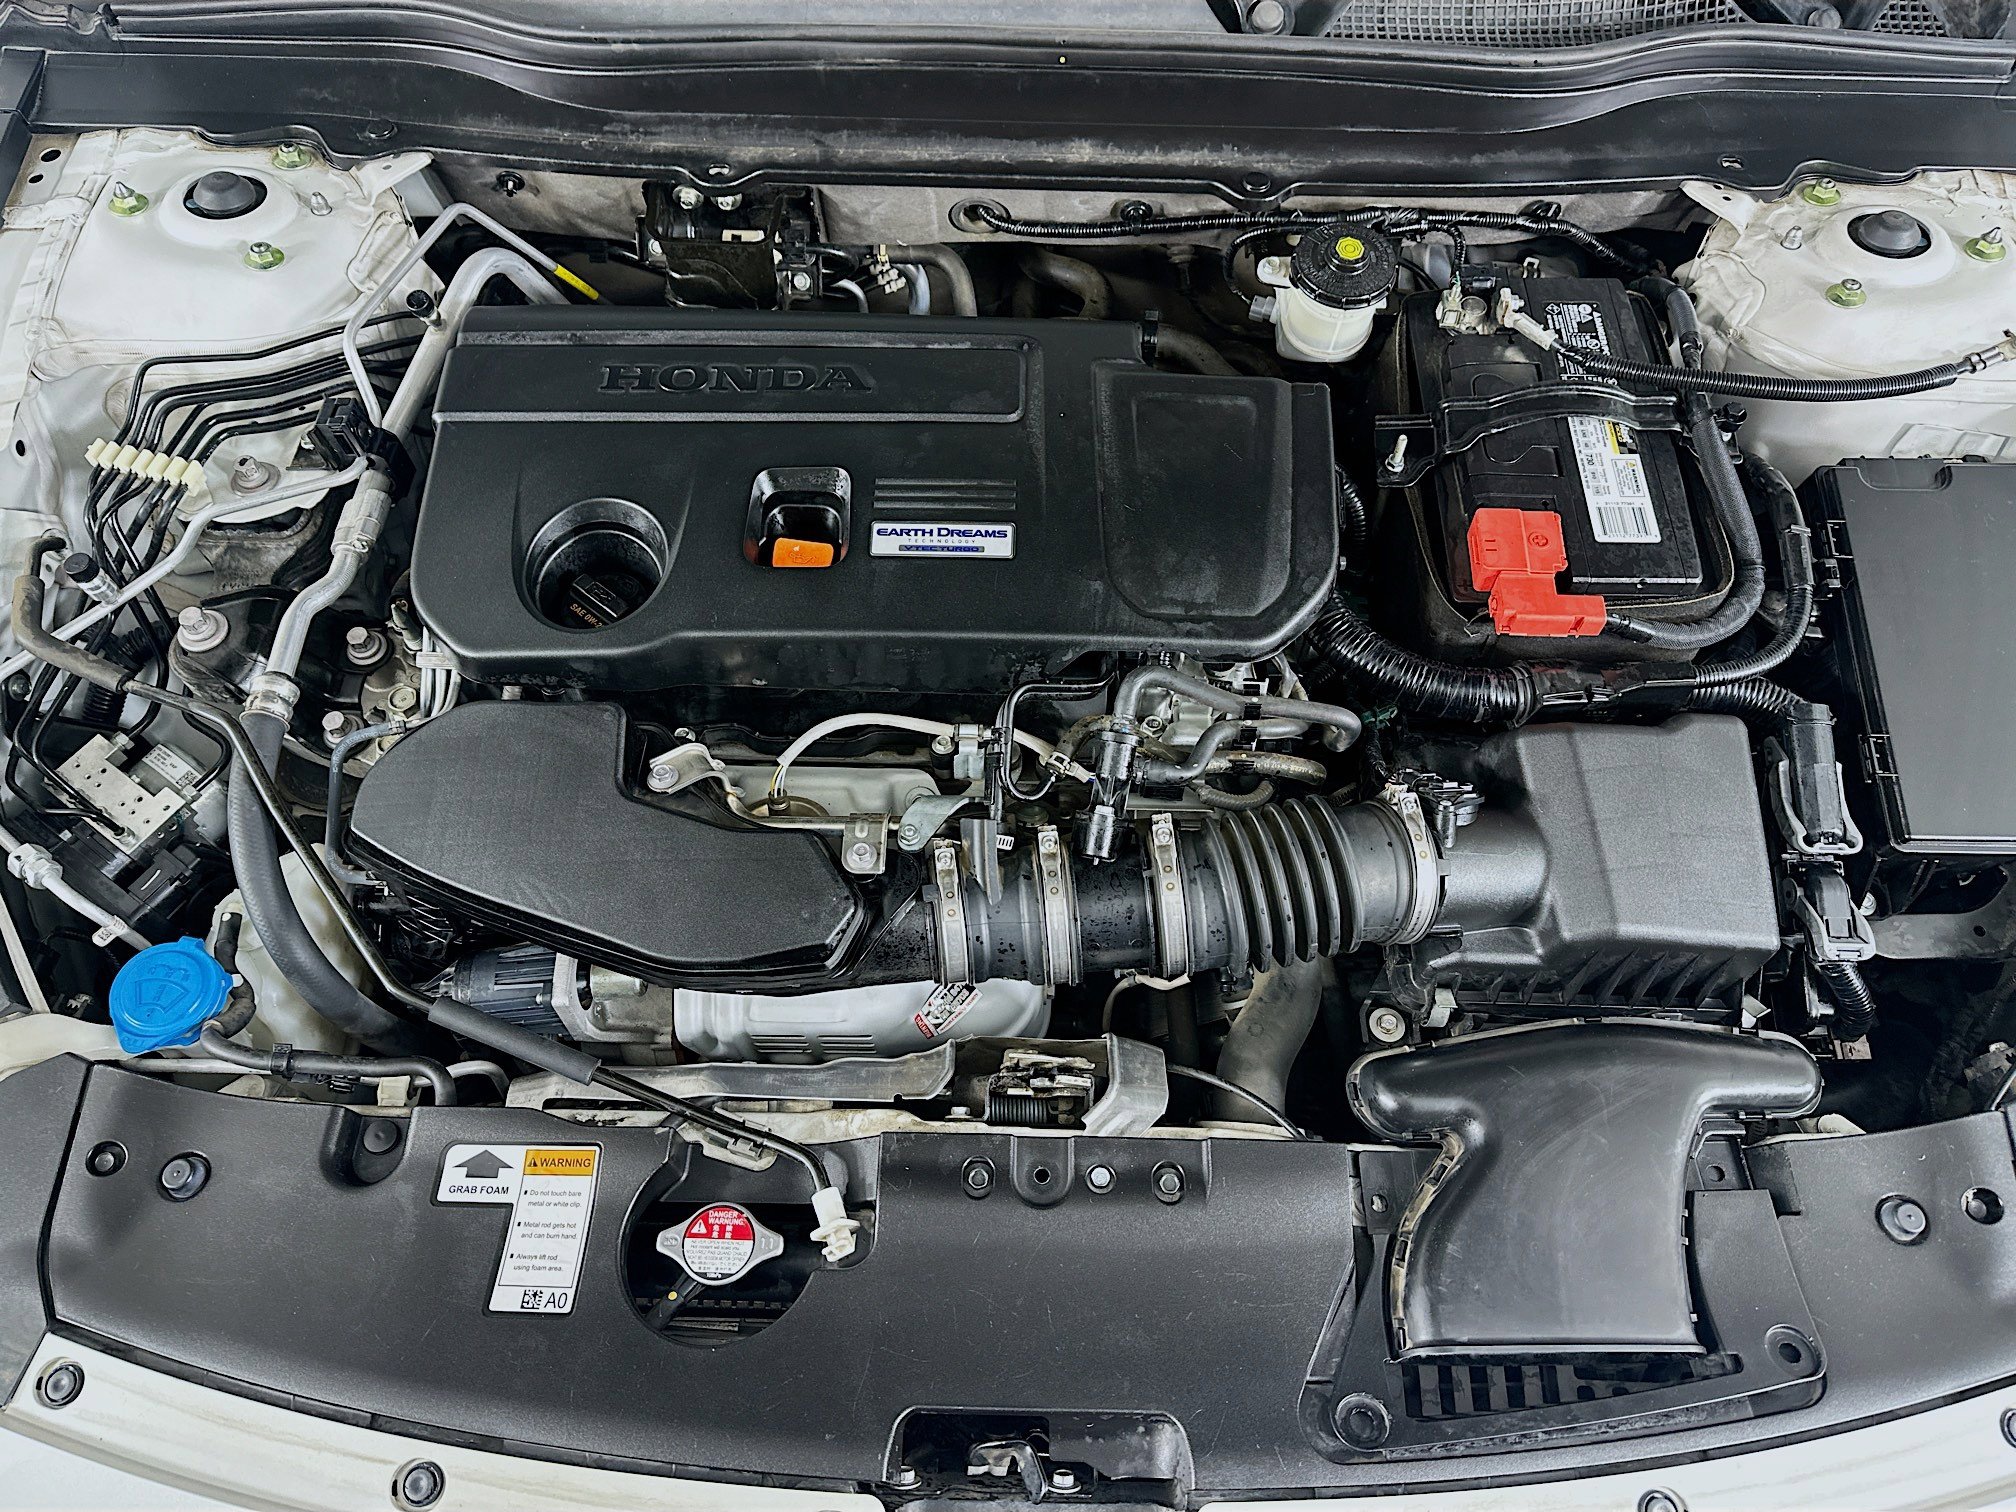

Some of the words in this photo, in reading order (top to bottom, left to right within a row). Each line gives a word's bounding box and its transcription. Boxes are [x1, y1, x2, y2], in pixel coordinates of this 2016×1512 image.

[598, 363, 874, 394] HONDA
[1585, 453, 1594, 466] 730
[877, 528, 934, 537] EARTH
[937, 527, 1008, 538] DREAMS
[570, 603, 587, 618] SAE
[540, 1158, 591, 1168] WARNING
[448, 1185, 477, 1194] GRAB
[480, 1186, 509, 1195] FOAM
[709, 1210, 738, 1218] DANGER
[513, 1264, 531, 1272] using
[544, 1292, 568, 1309] A0
